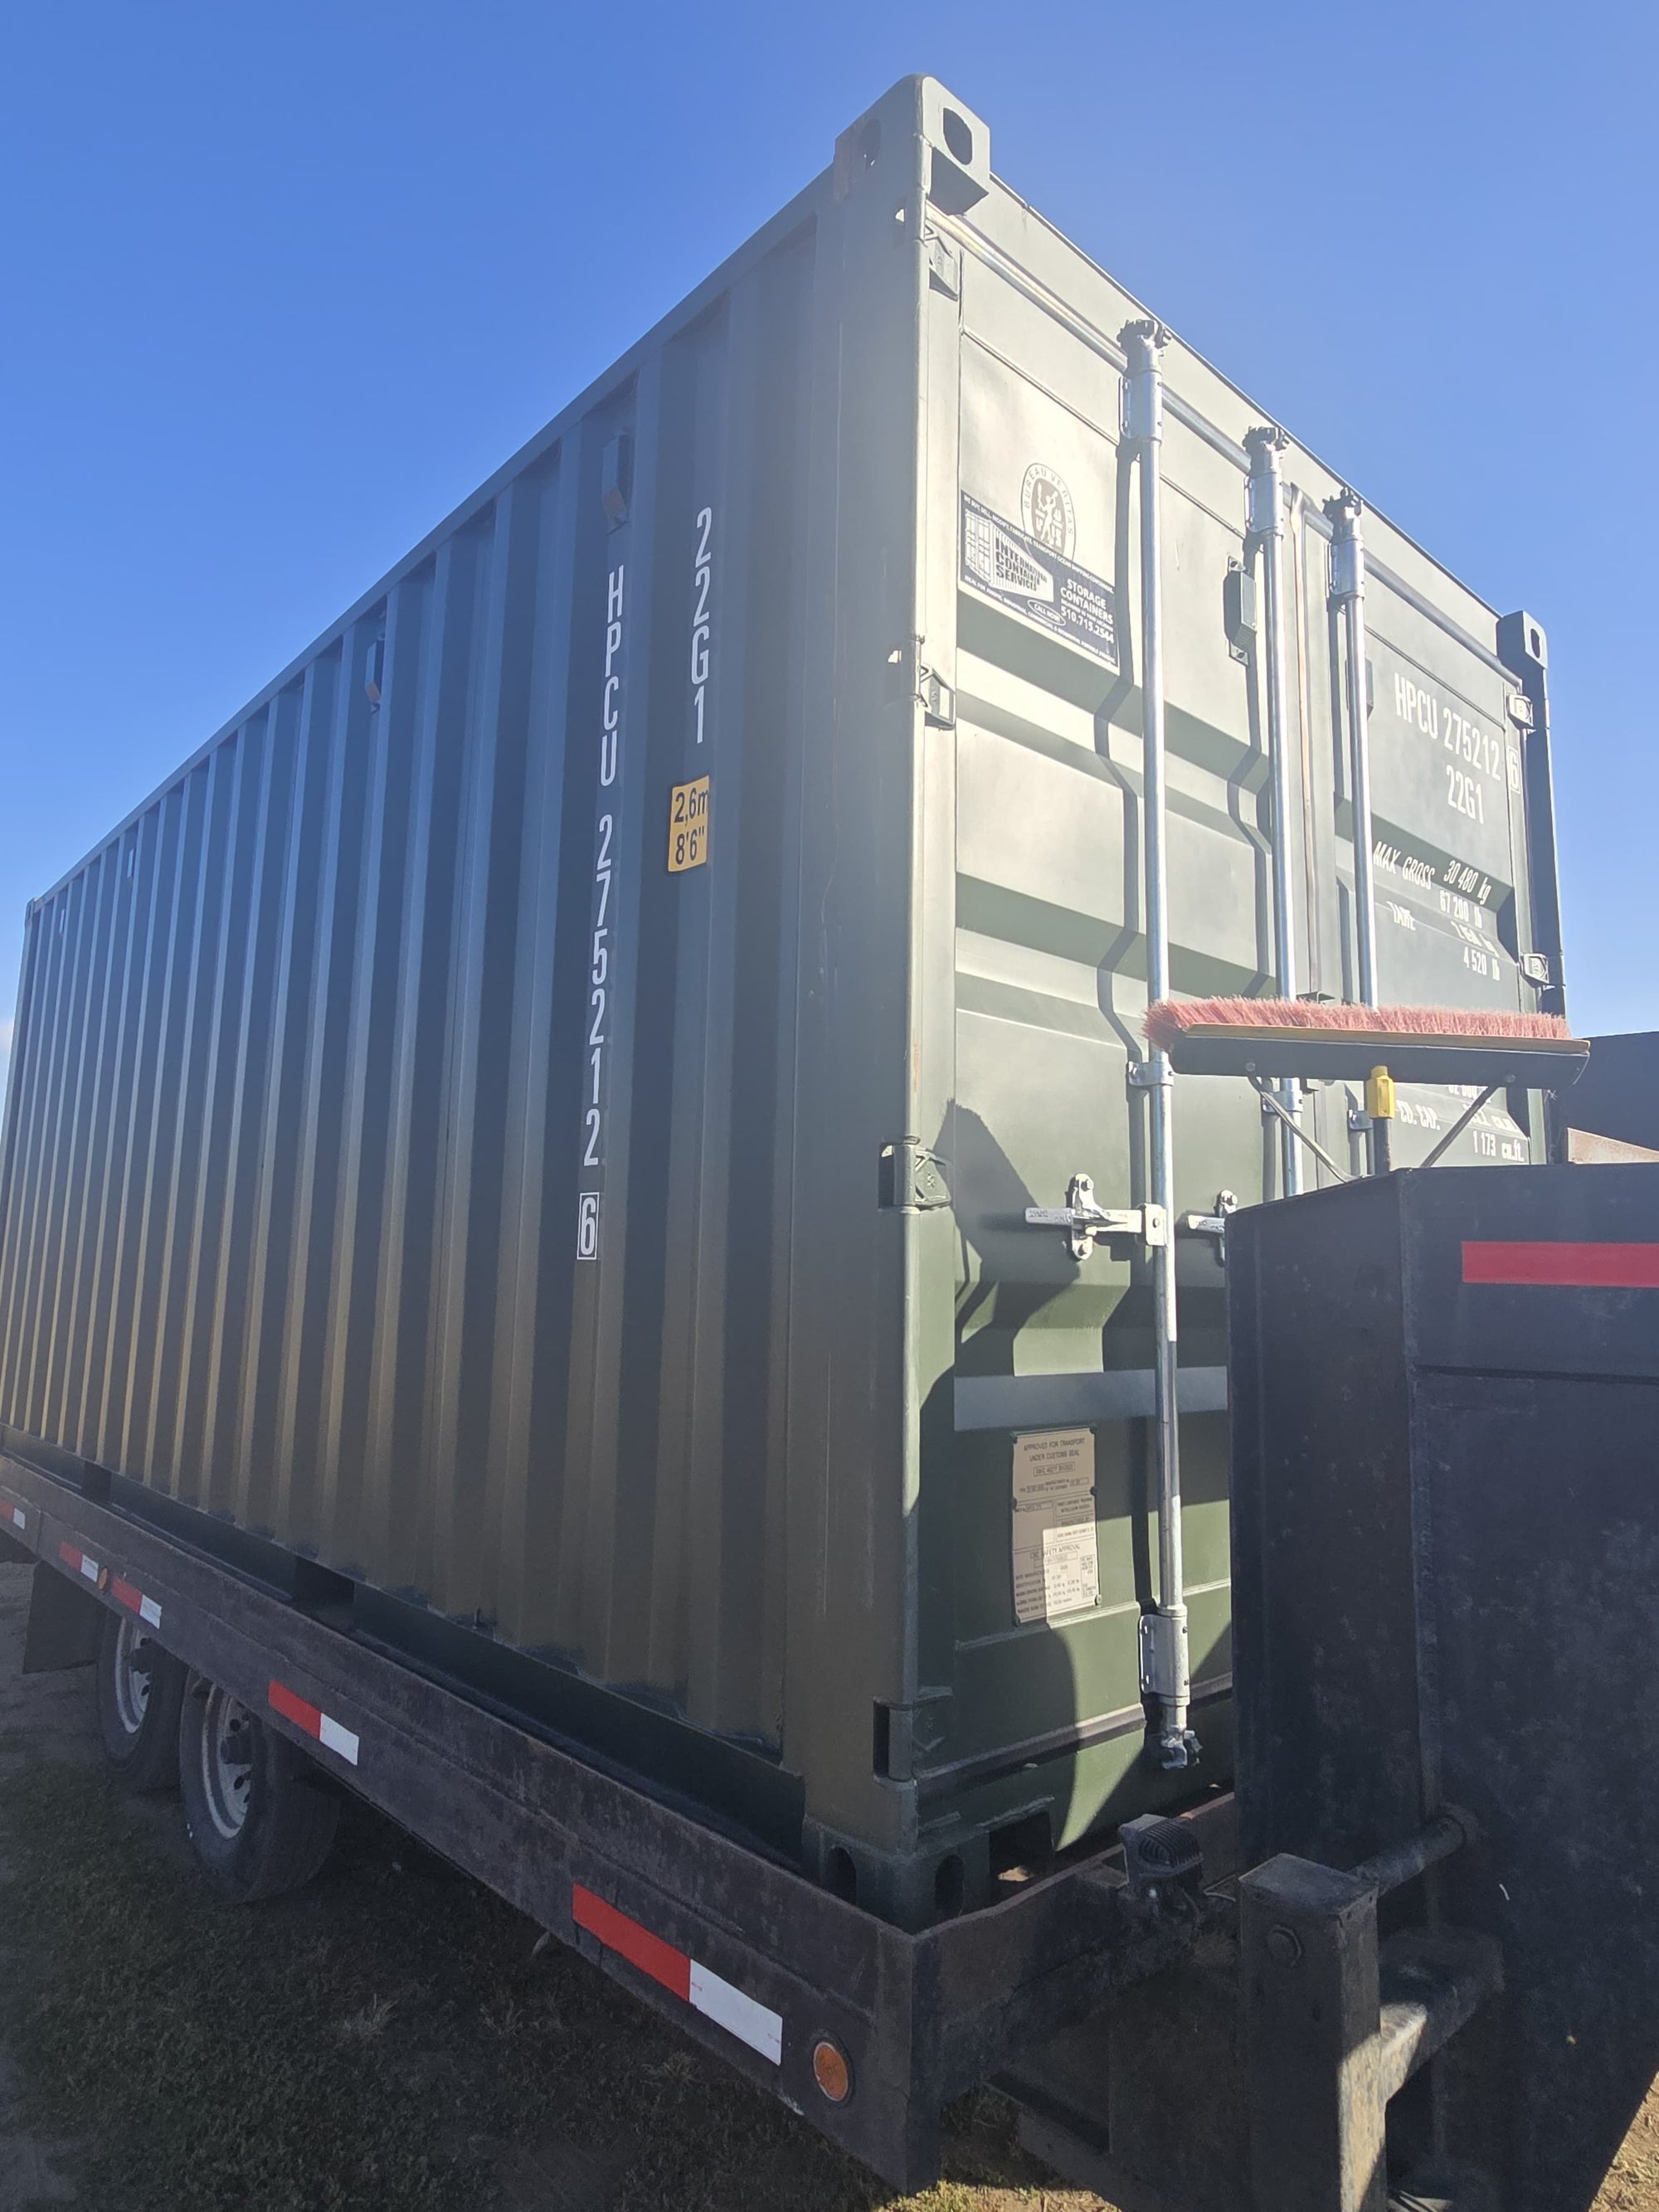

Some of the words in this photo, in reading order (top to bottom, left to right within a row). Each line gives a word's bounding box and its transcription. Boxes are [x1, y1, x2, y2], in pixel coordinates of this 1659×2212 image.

[1024, 467, 1047, 509] BUREAU
[1050, 472, 1074, 536] VERITAS
[995, 537, 1048, 583] INTERNATIONAL
[995, 564, 1037, 591] SERVICES
[1034, 603, 1046, 615] CALL
[1060, 586, 1114, 625] CONTAINERS
[1067, 578, 1107, 610] STORAGE
[690, 506, 713, 744] 22G1
[1060, 605, 1115, 644] 510.715.2544
[600, 564, 625, 787] HPCU
[1394, 672, 1439, 740] HPCU
[1443, 707, 1501, 781] 275212
[1508, 750, 1520, 790] 6
[674, 786, 708, 828] 2,6m
[1446, 764, 1485, 824] 22G1
[1373, 840, 1402, 875] MAX
[1402, 856, 1436, 890] GROSS
[1477, 876, 1492, 906] kg
[1462, 946, 1471, 969] 4
[1471, 949, 1487, 976] 520
[1491, 957, 1501, 981] lb
[583, 814, 613, 1167] 275212
[1414, 1104, 1441, 1131] CAP.
[1481, 1132, 1496, 1157] 173
[579, 1195, 598, 1257] 6
[1023, 1441, 1048, 1451] APPROVED
[1048, 1440, 1058, 1448] FOR
[1059, 1437, 1085, 1447] TRANSPORT
[1029, 1453, 1045, 1462] UNDER
[1045, 1450, 1067, 1460] CUSTOMS
[1058, 1543, 1081, 1553] APPROVAL
